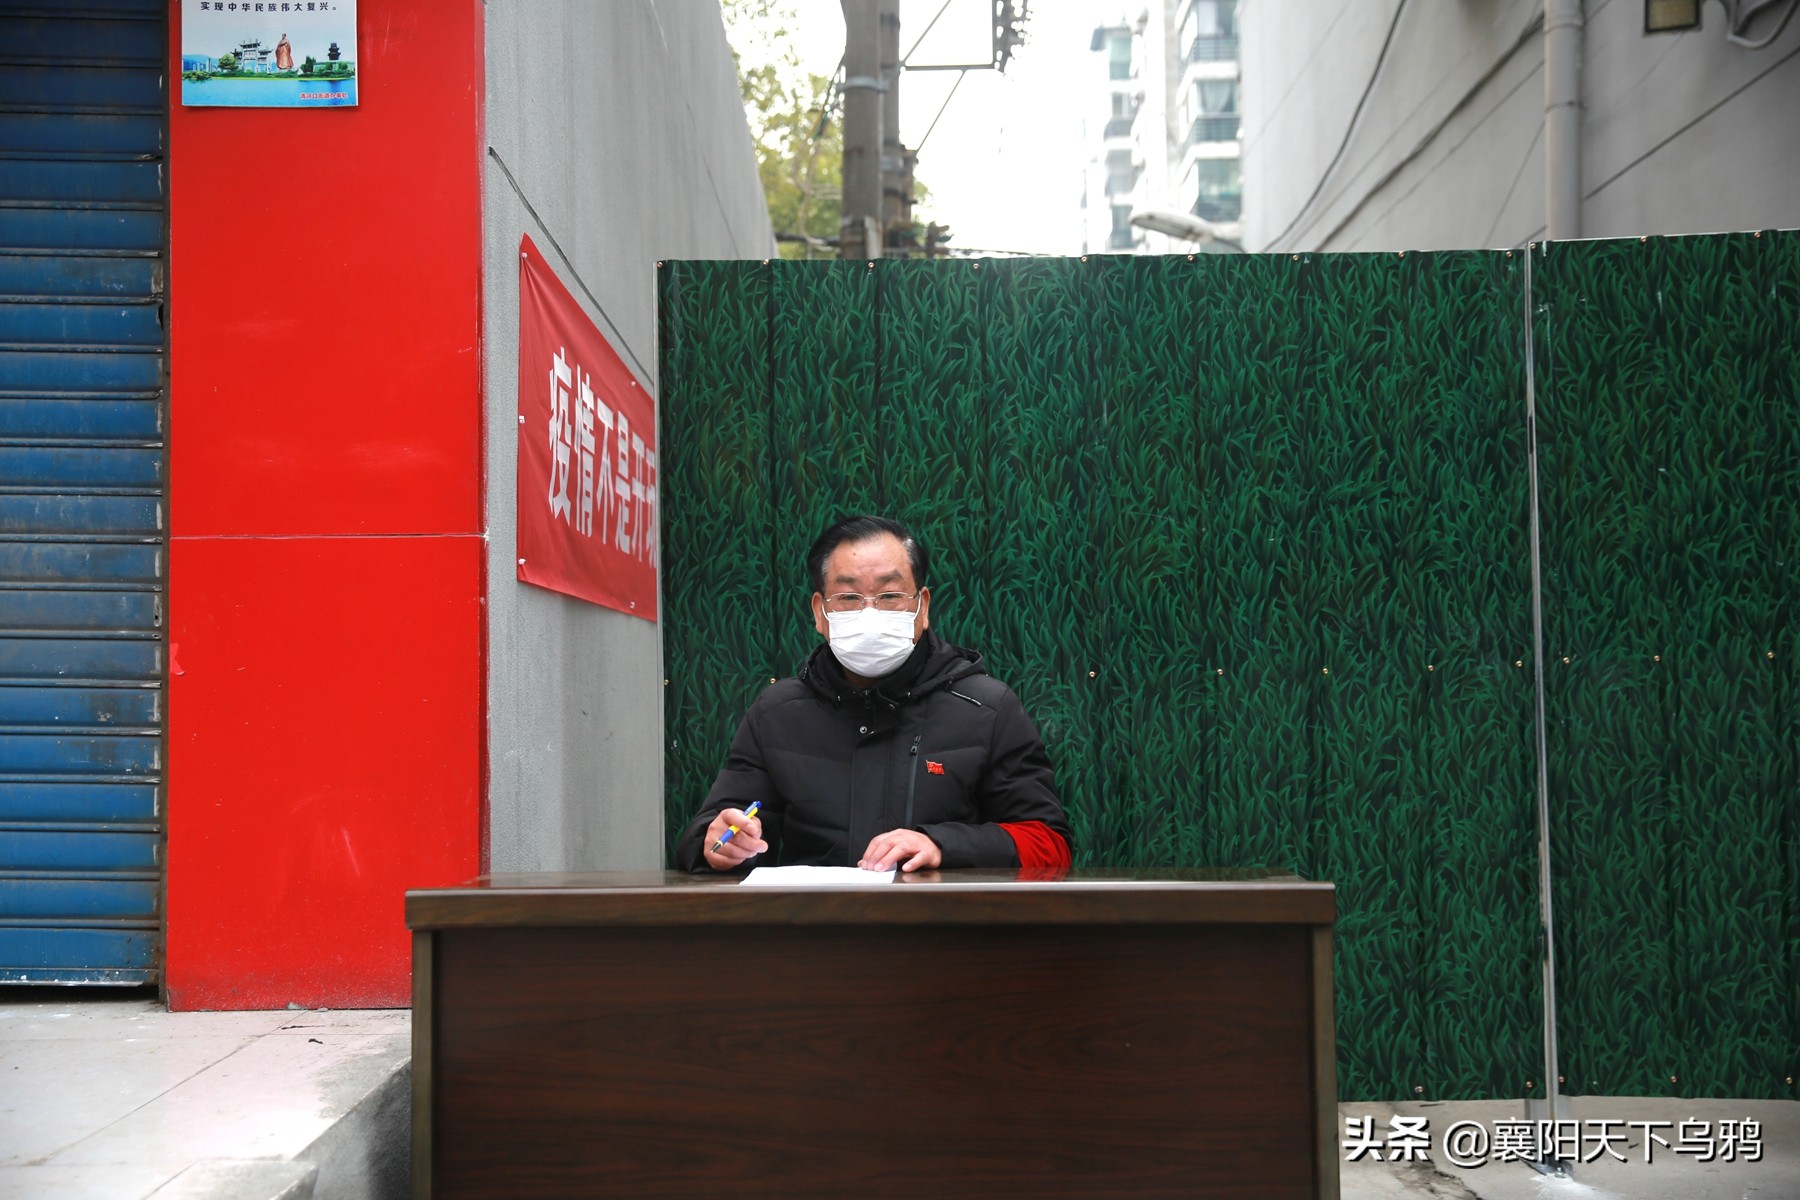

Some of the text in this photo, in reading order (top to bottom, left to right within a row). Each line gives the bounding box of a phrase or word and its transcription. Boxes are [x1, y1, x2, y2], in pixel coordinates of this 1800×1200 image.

[200, 1, 337, 12] 实现中华民族伟大复兴。
